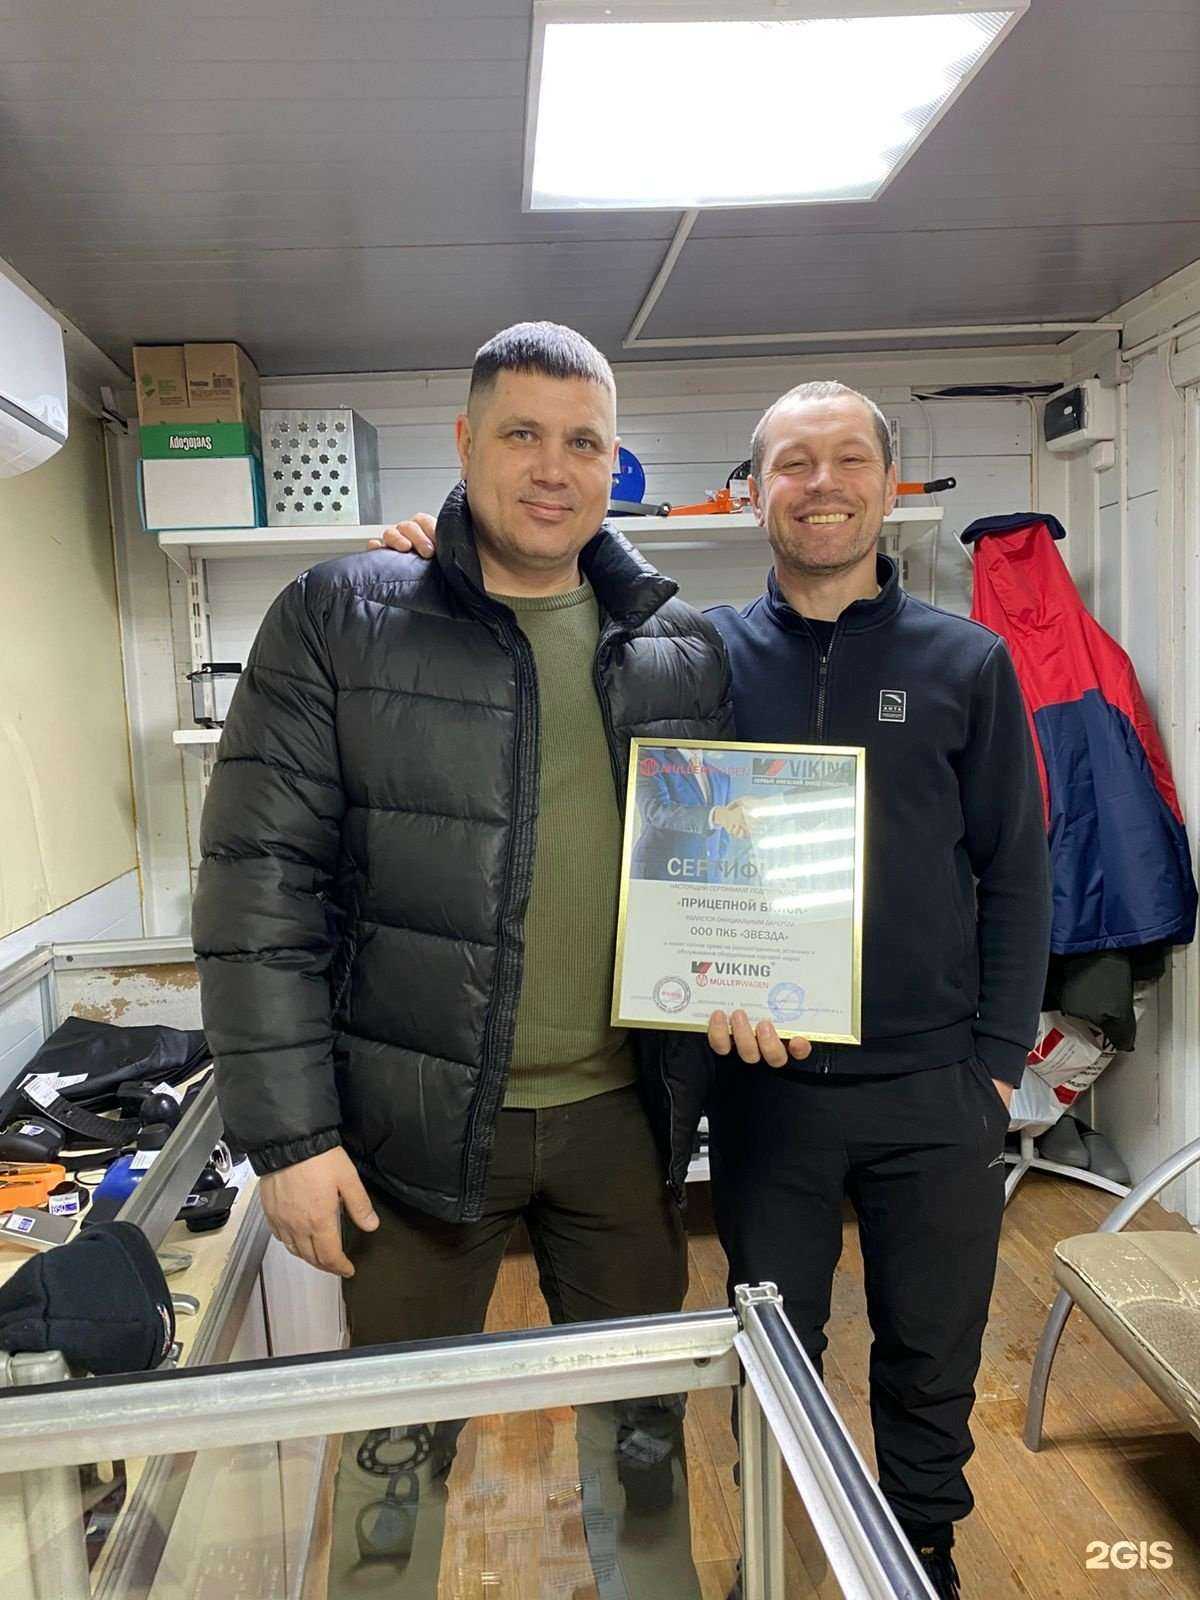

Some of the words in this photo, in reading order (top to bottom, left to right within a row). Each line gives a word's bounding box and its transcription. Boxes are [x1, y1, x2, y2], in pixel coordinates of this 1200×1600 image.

[169, 436, 212, 450] SvetoCopy
[716, 927, 737, 938] ПКБ
[715, 961, 772, 978] VIKING
